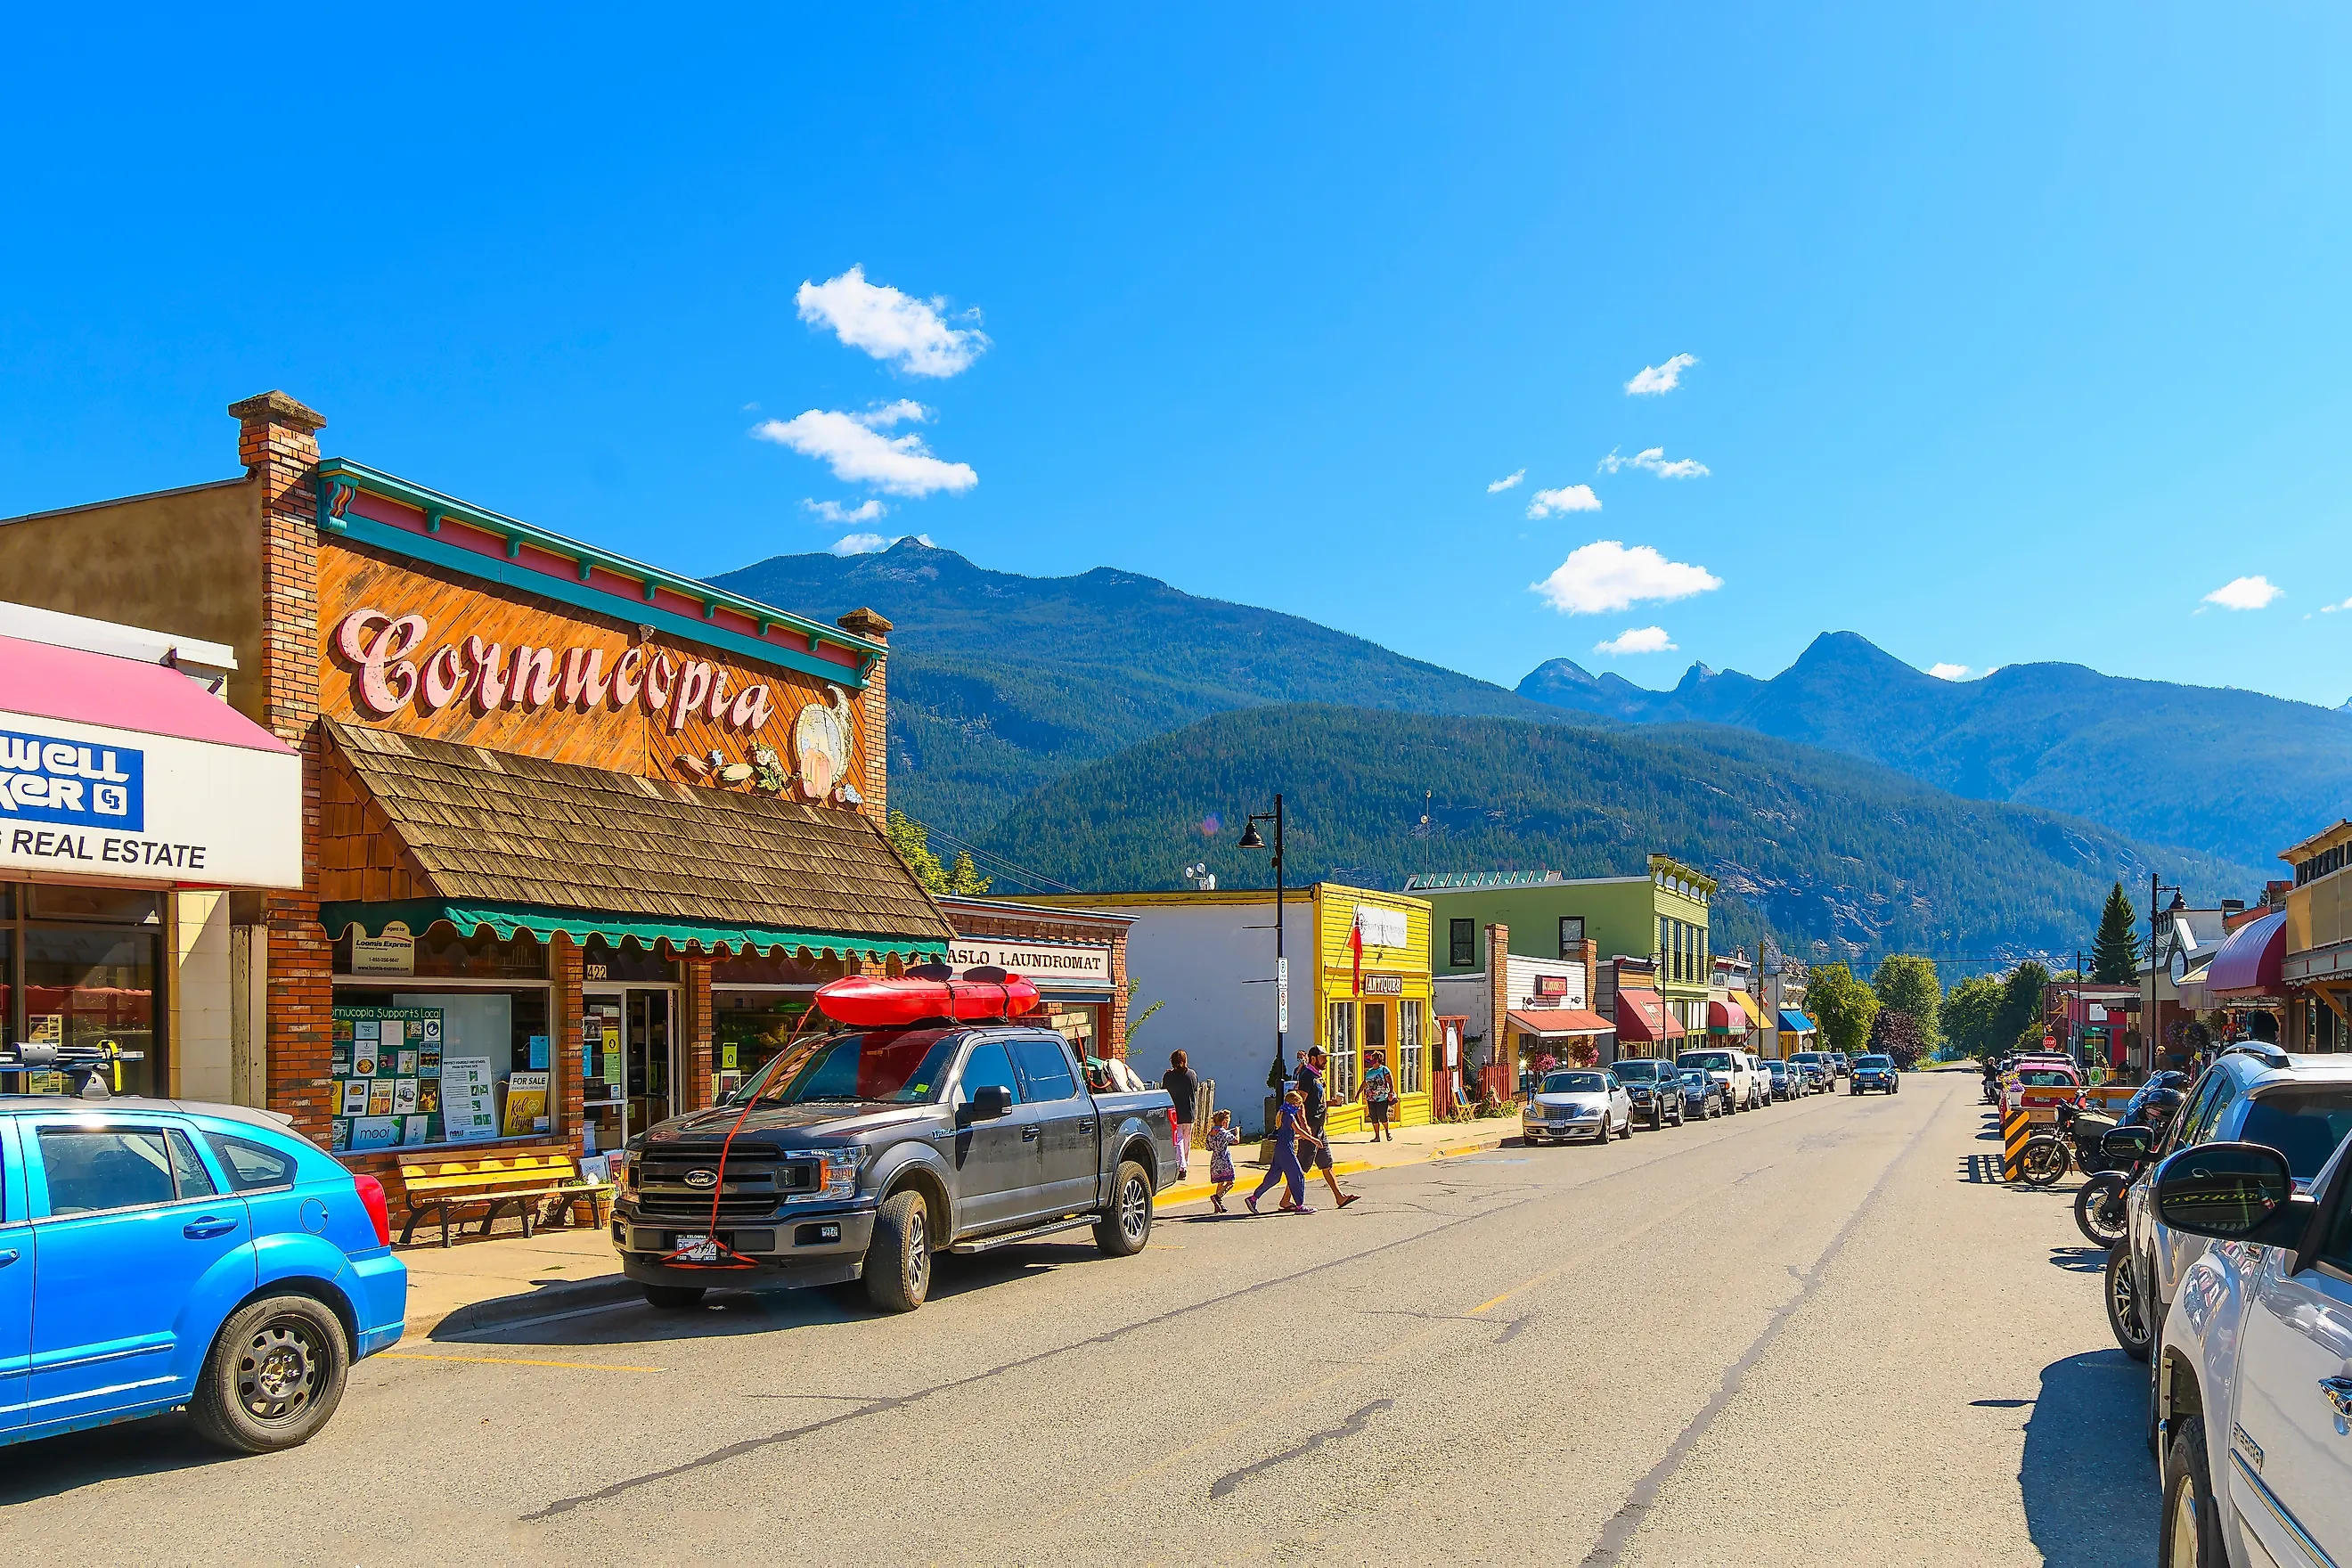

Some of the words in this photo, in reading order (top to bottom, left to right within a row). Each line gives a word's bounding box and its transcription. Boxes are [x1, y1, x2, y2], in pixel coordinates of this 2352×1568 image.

[337, 608, 775, 731] Cornucopia
[12, 829, 93, 860] REAL
[102, 838, 206, 869] ESTATE
[383, 940, 412, 949] Express
[946, 949, 990, 965] ASLO
[1000, 951, 1101, 970] LAUNDROMAT
[588, 965, 607, 980] 422
[1367, 976, 1401, 994] ANTIQUES
[377, 1008, 419, 1019] Supports
[421, 1008, 441, 1019] Local
[513, 1077, 527, 1085] FOR
[528, 1076, 546, 1085] SALE
[359, 1125, 390, 1139] mooi
[690, 1172, 710, 1183] Ford
